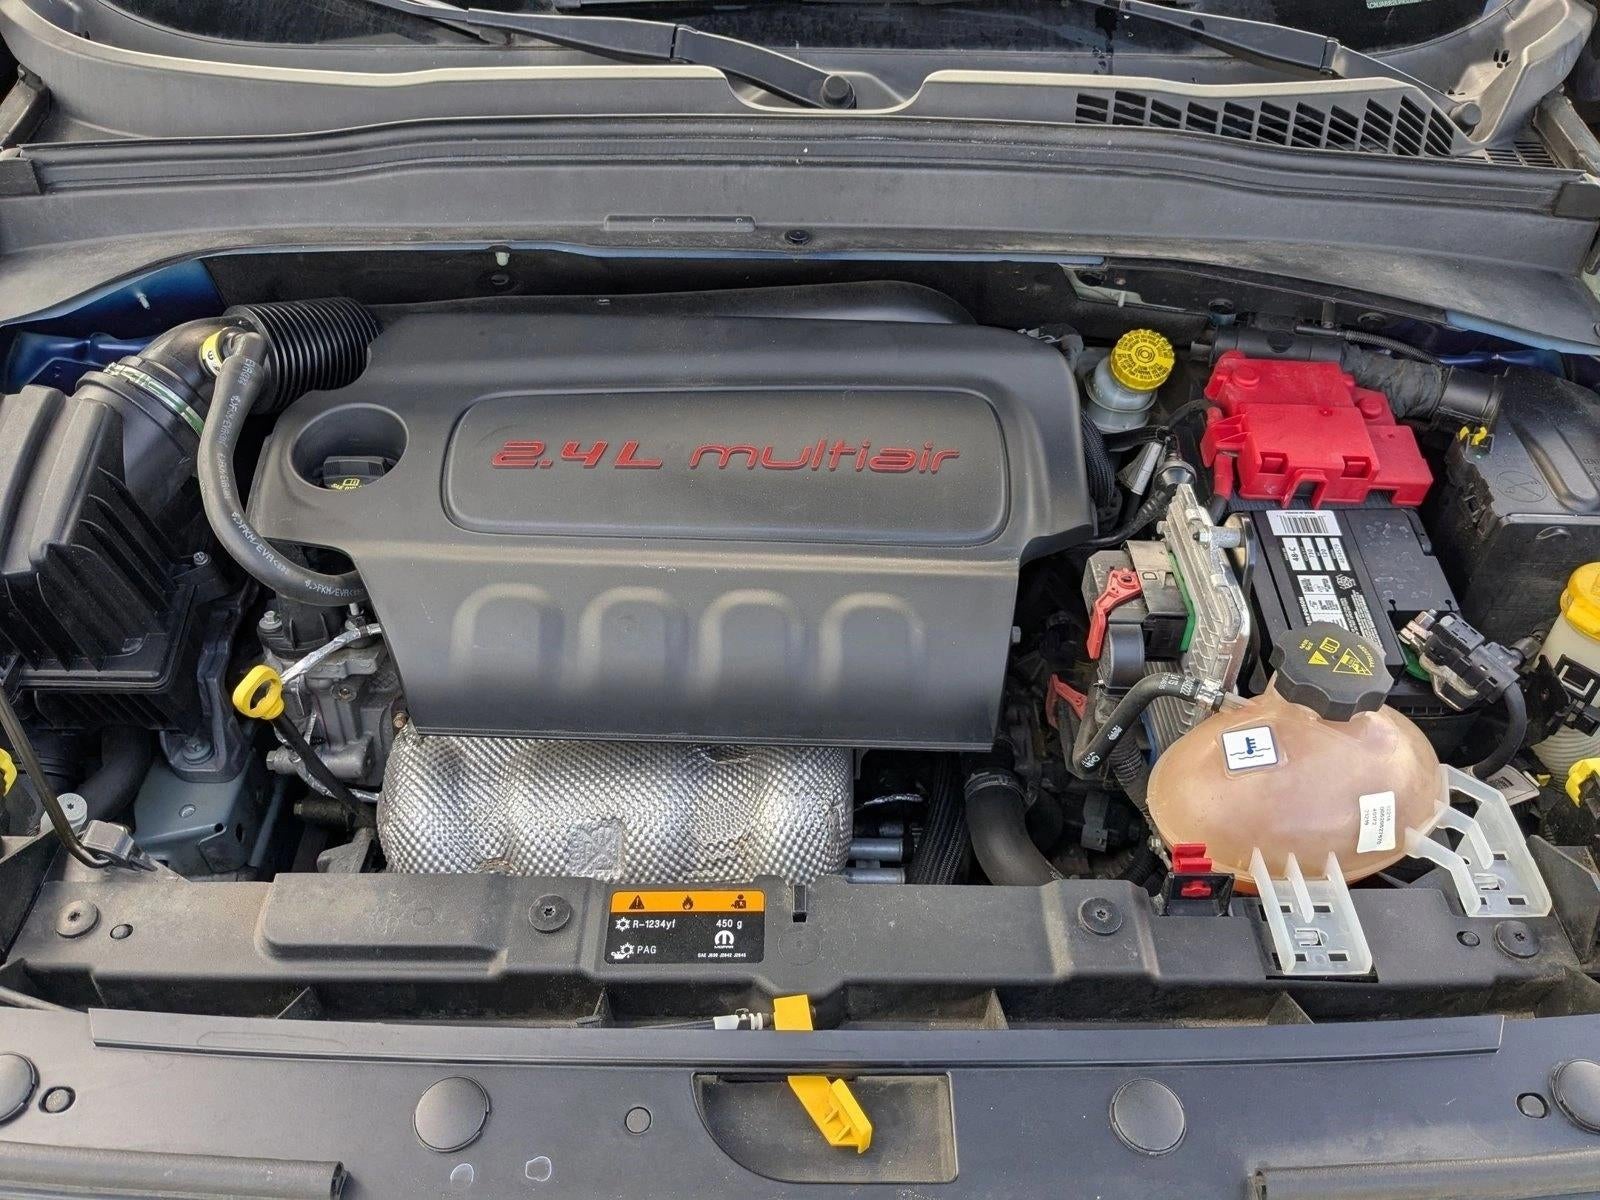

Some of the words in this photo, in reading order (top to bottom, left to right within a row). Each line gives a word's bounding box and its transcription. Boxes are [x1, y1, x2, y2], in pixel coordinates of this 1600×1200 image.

[688, 438, 960, 473] multiair
[632, 918, 676, 931] R-1234yf
[715, 918, 734, 928] 450
[736, 920, 743, 930] g
[636, 945, 657, 955] PAG
